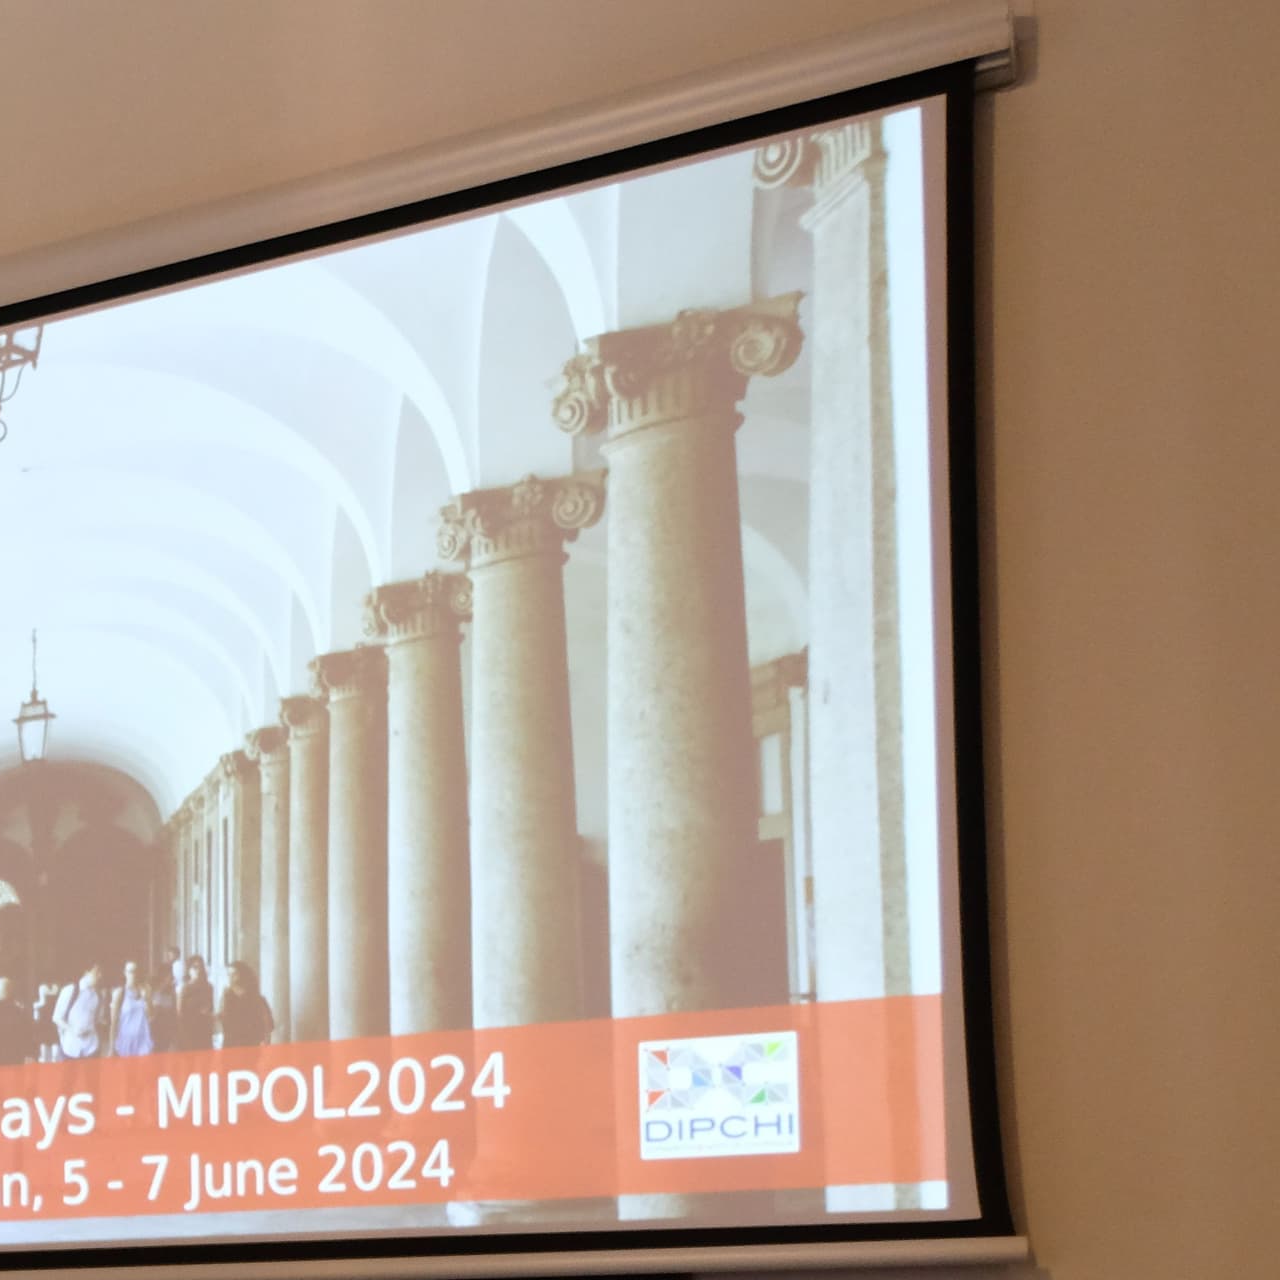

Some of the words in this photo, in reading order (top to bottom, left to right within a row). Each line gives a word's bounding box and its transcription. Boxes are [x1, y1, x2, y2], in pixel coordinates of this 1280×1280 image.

[115, 1105, 135, 1116] -
[156, 1051, 512, 1129] MIPOL2024
[644, 1112, 794, 1143] DIPCHI
[62, 1158, 90, 1206] 5
[140, 1154, 169, 1201] 7
[183, 1152, 299, 1212] June
[316, 1138, 455, 1193] 2024
